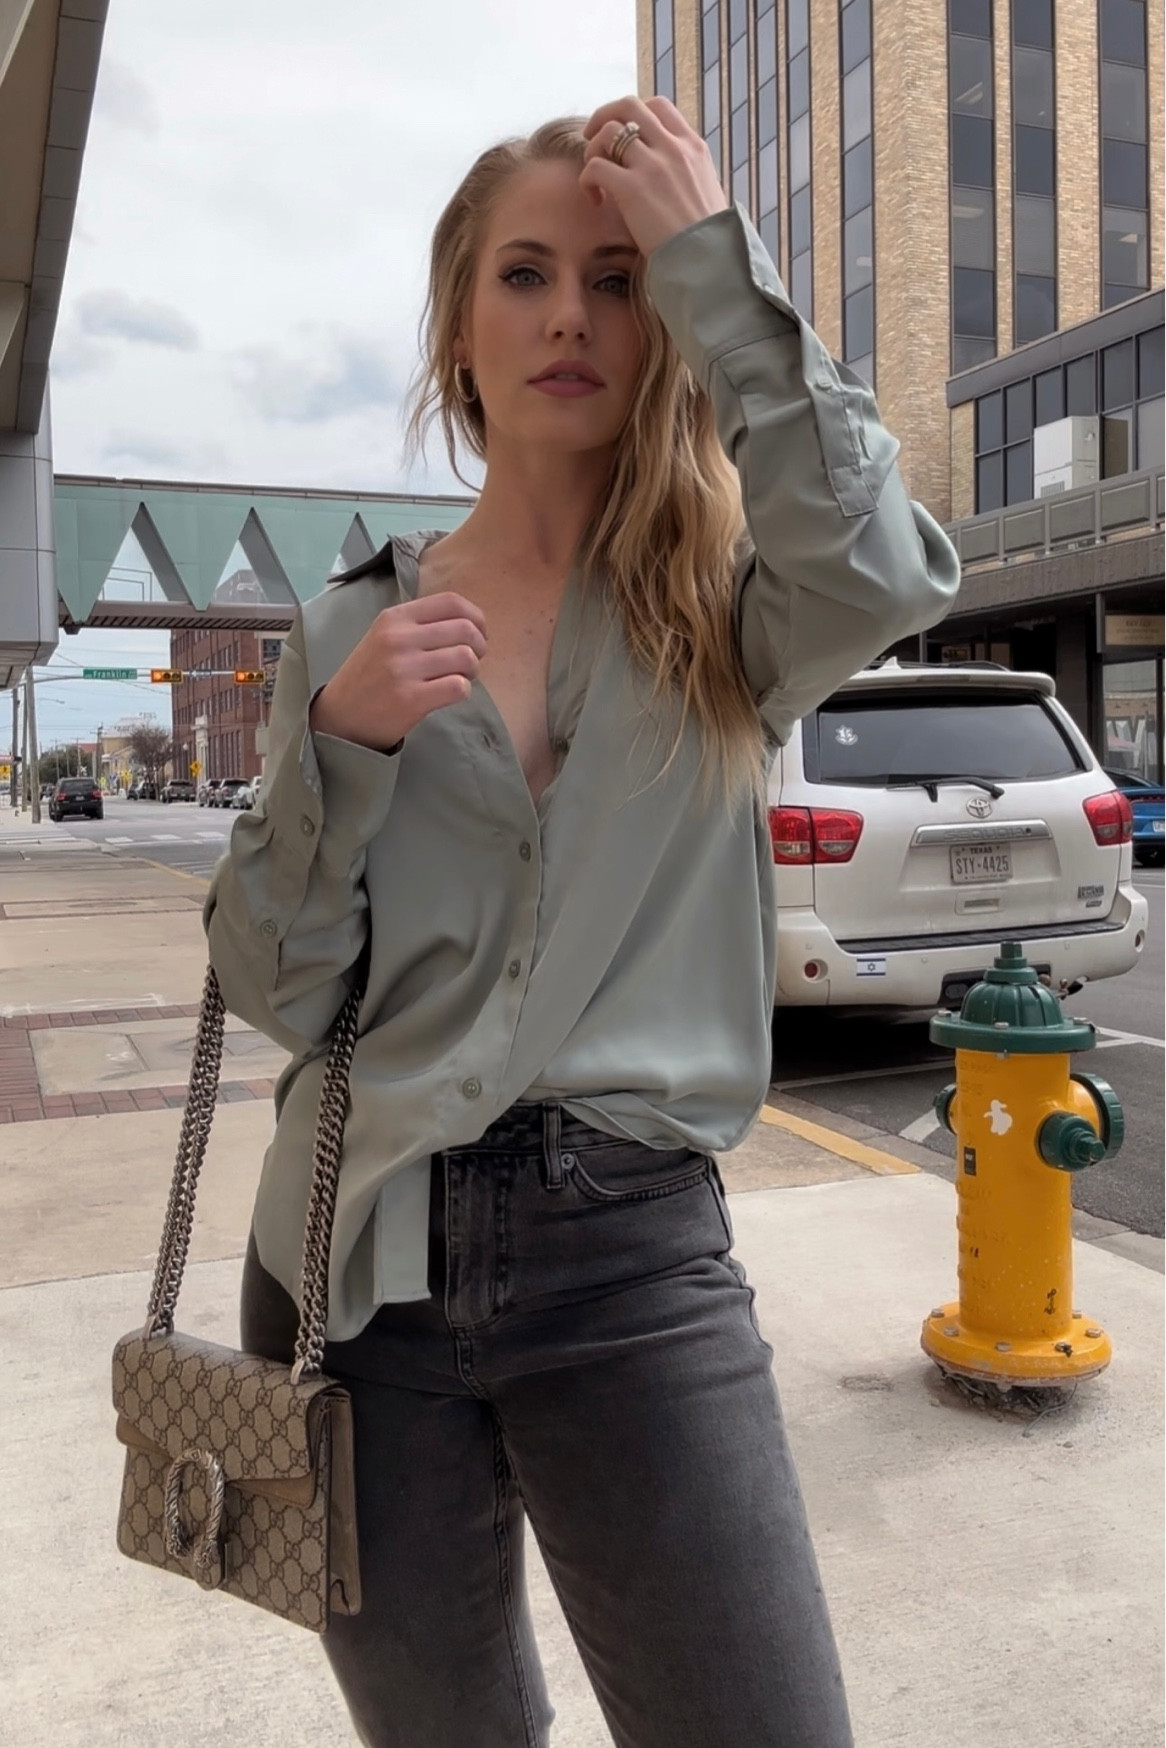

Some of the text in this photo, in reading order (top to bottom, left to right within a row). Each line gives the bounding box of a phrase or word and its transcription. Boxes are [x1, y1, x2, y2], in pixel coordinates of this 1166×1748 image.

[92, 669, 127, 679] Franklin
[943, 826, 1026, 841] SEQUOIA
[969, 847, 993, 855] TEXAS
